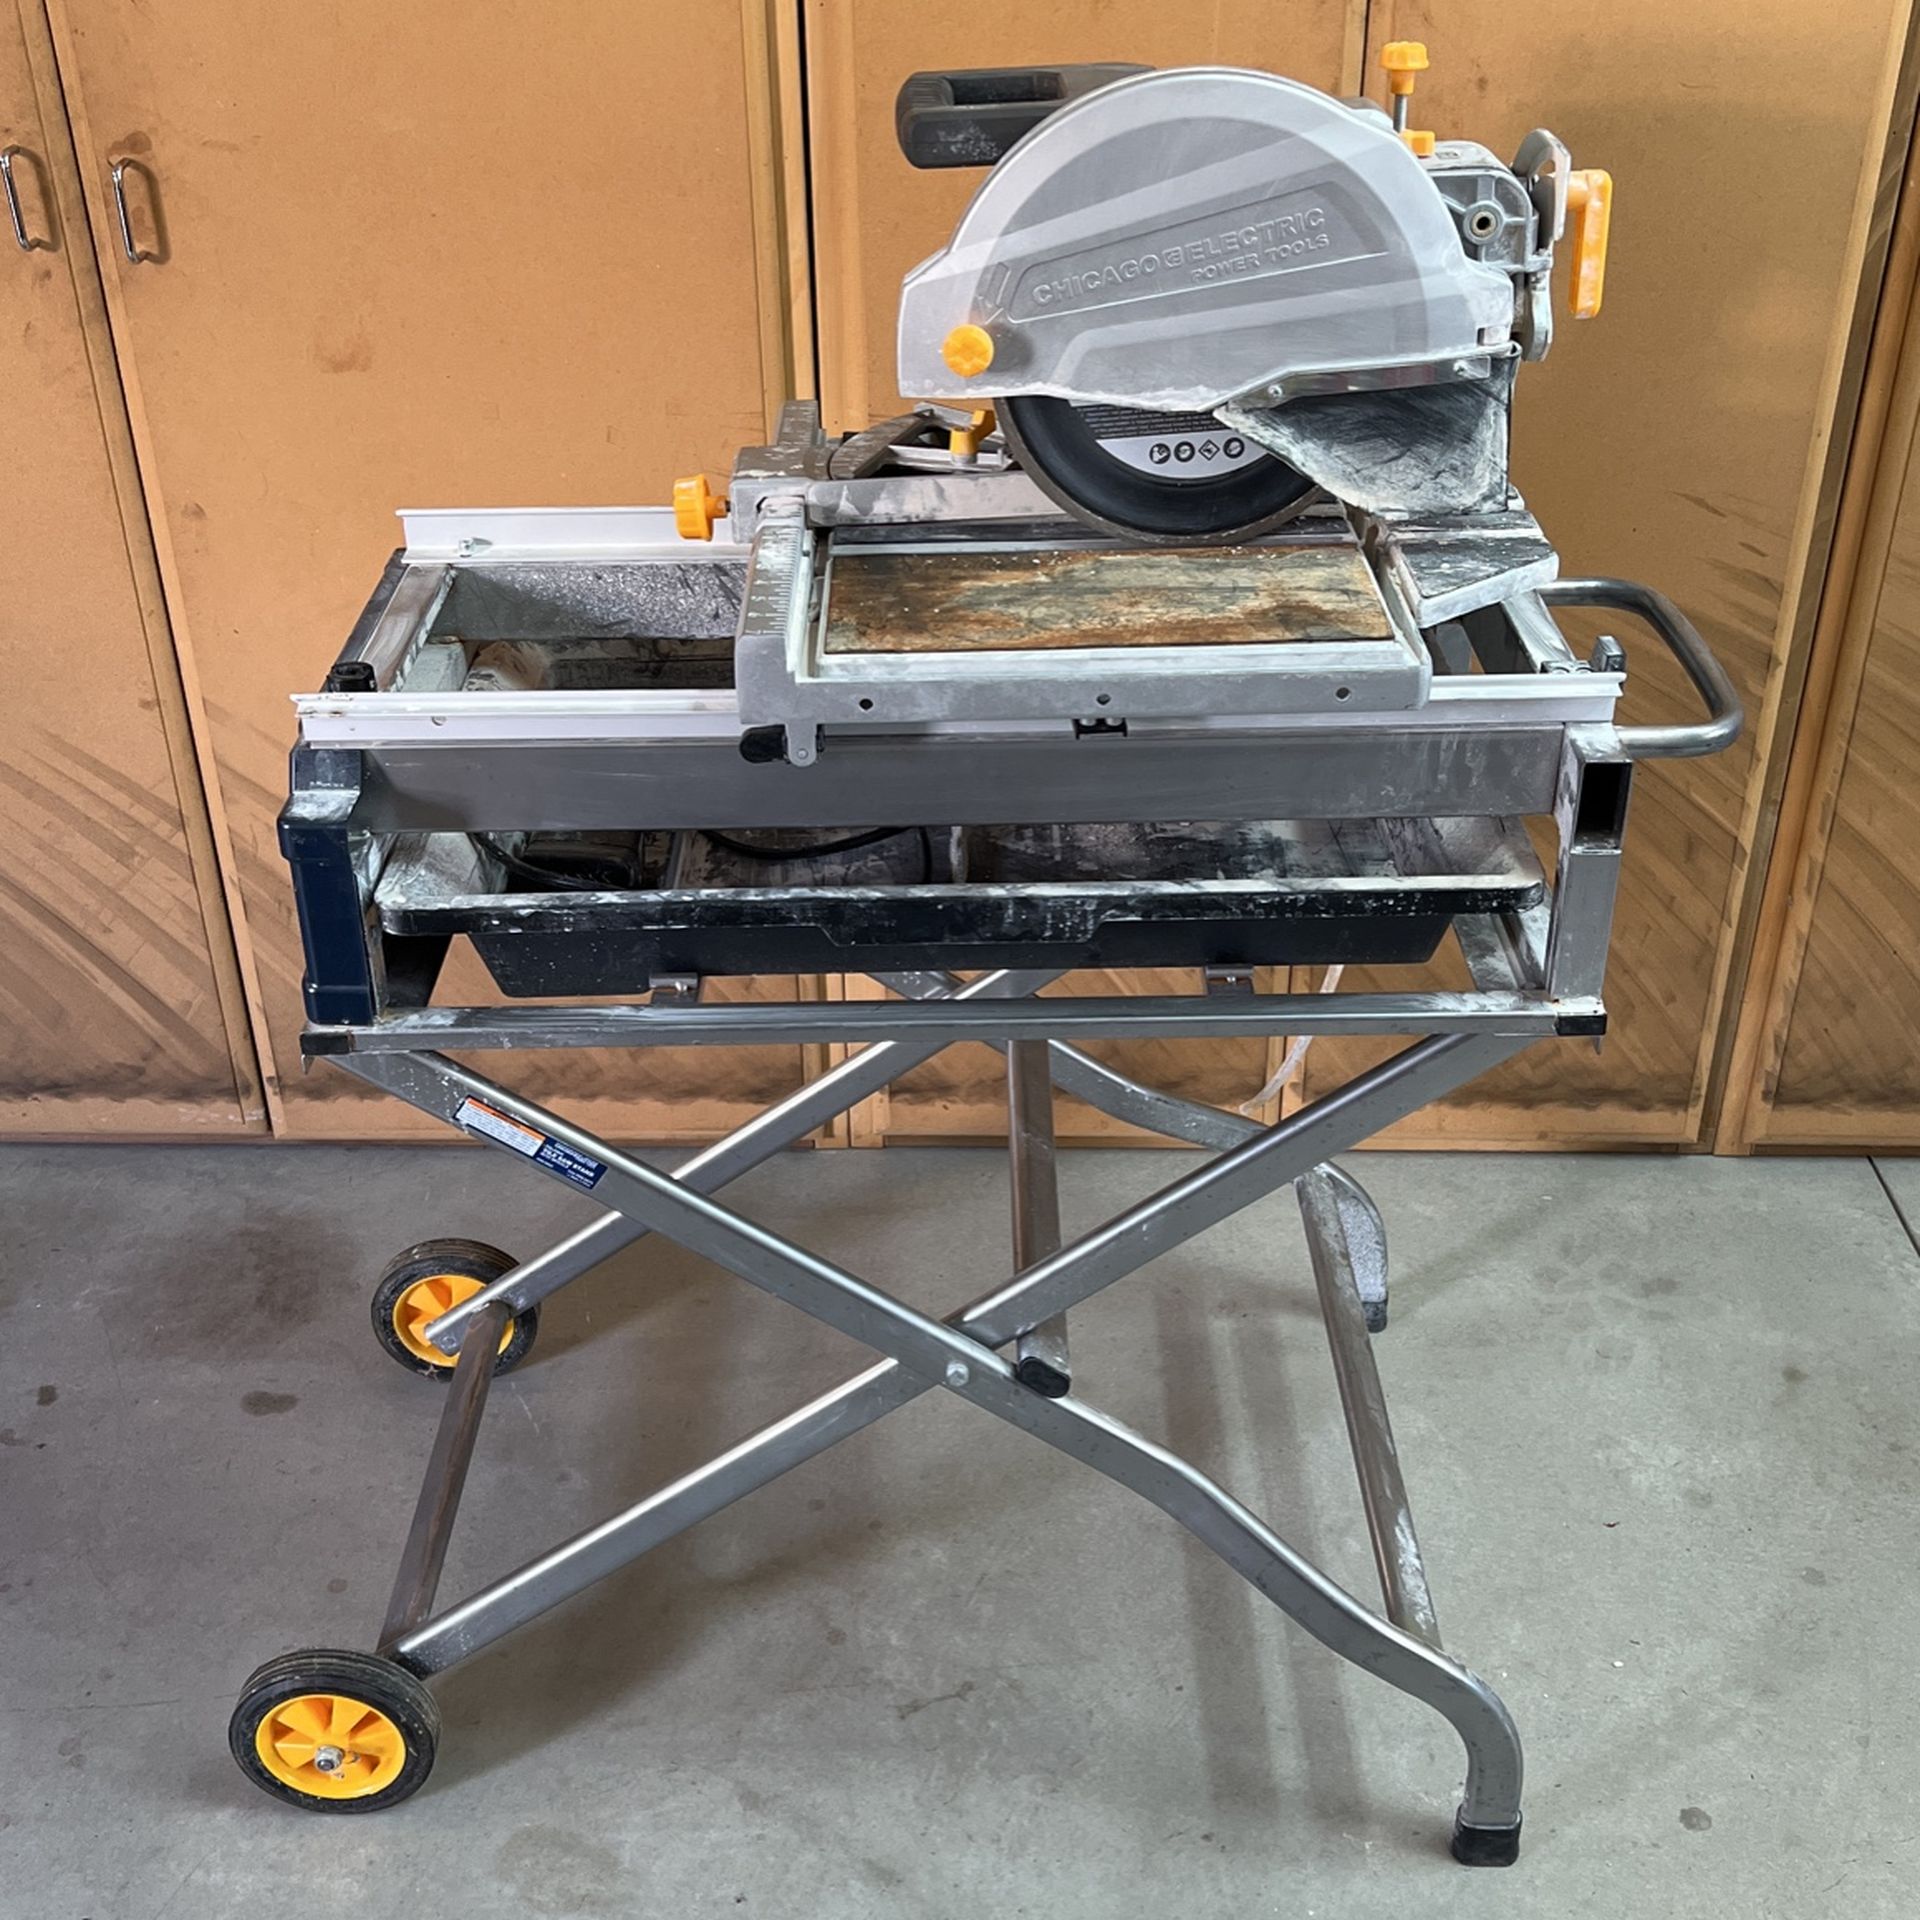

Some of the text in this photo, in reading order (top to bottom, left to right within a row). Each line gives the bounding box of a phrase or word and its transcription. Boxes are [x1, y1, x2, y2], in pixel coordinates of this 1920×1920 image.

[1031, 253, 1160, 306] CHICAGO
[1184, 207, 1325, 262] ELECTRIC
[1191, 234, 1329, 284] POWER TOOLS
